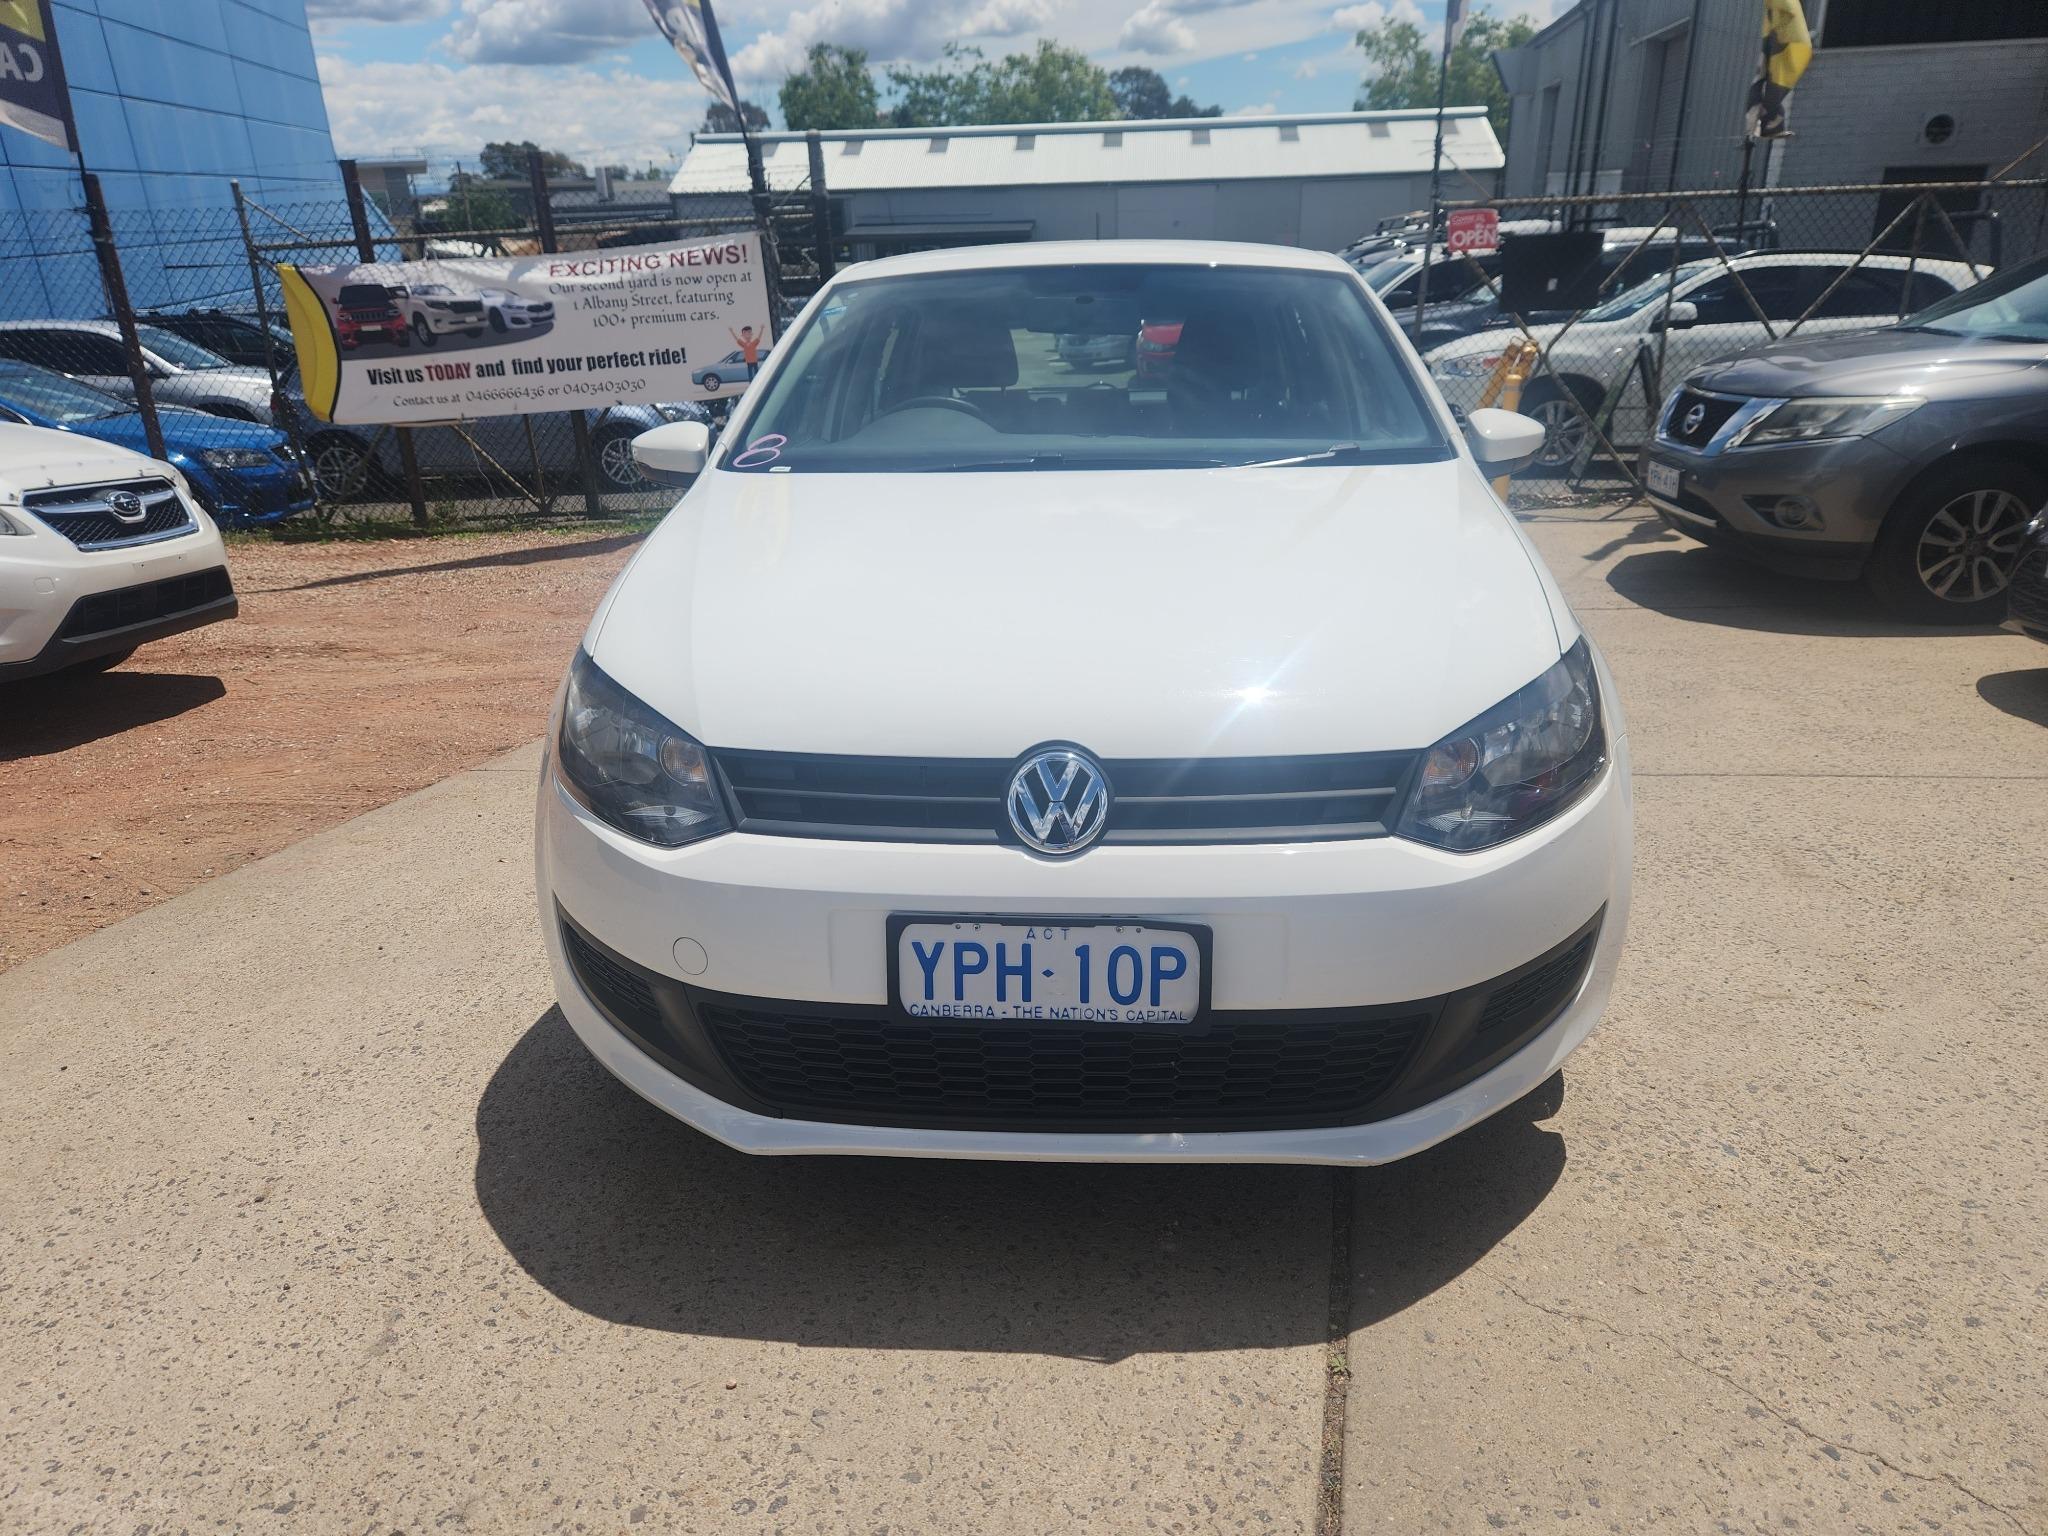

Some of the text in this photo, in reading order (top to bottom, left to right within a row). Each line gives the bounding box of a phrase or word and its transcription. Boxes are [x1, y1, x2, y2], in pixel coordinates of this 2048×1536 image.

[1452, 228, 1498, 247] OPEN
[549, 244, 749, 278] EXCITING NEWS!
[549, 271, 752, 295] Our second yard is now open at
[582, 295, 629, 313] Albany
[631, 291, 673, 308] Street,
[675, 287, 735, 306] featuring
[592, 309, 720, 330] 100+ premium cars.
[367, 347, 688, 386] Visit us TODAY and find your perfect ride!
[392, 395, 434, 408] Contact
[436, 396, 449, 405] us
[451, 393, 461, 404] at
[548, 387, 560, 396] or
[563, 378, 647, 396] 0403403030
[732, 433, 788, 468] 8
[1026, 927, 1071, 941] ACT
[909, 1003, 996, 1018] CANBERRA
[1012, 1005, 1043, 1019] THE
[1049, 1006, 1119, 1021] NATION'S
[1126, 1009, 1188, 1022] CAPITAL
